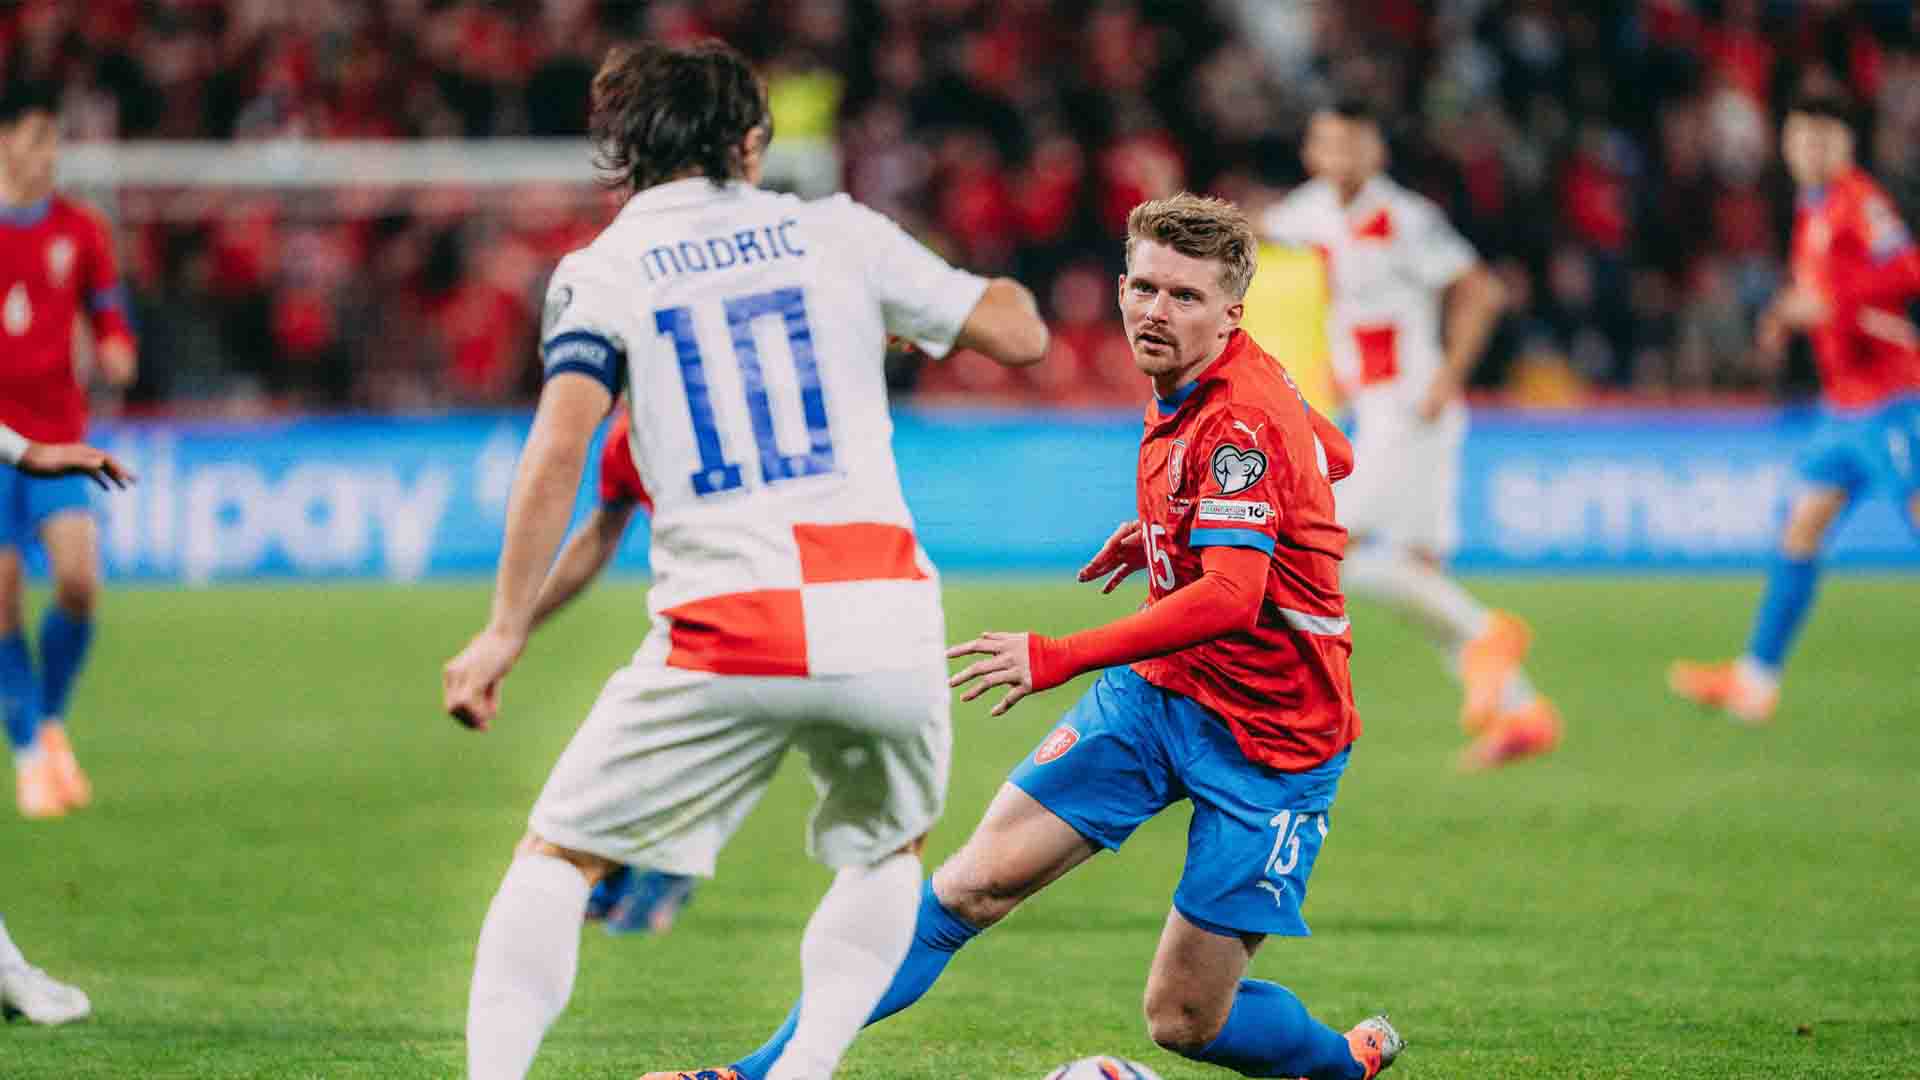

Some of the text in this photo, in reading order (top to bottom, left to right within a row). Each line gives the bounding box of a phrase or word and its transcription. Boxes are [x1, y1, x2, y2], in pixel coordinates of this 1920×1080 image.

[654, 287, 835, 497] 10
[103, 424, 452, 590] lipay
[1142, 520, 1176, 591] 15
[1264, 809, 1309, 875] 15
